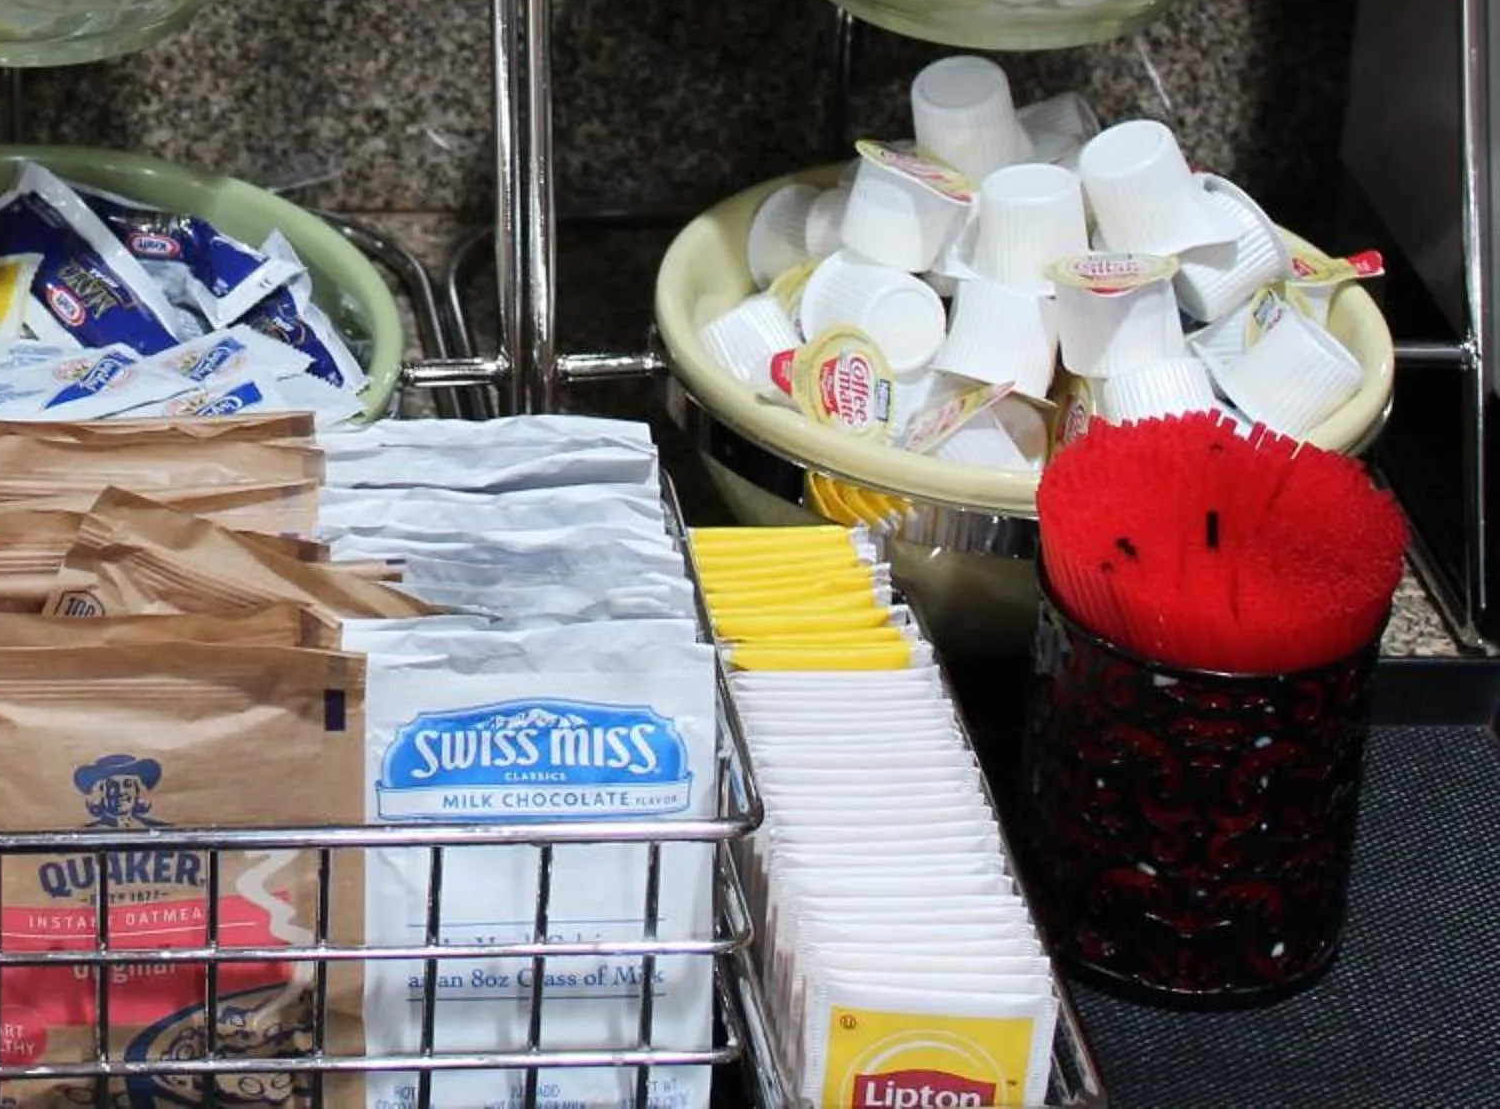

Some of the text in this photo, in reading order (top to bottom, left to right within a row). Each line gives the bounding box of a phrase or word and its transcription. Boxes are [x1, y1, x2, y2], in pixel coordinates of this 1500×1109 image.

[138, 237, 169, 252] Kraft
[849, 356, 869, 423] Coffee
[411, 724, 657, 779] SWISS MISS
[504, 771, 567, 782] CLASSICS
[442, 791, 678, 810] MILK CHOCOLATE FLAVOR
[37, 850, 201, 898] QUAKER
[125, 906, 203, 926] OATMEA
[471, 969, 509, 988] 8oz
[584, 965, 608, 986] of
[864, 1080, 981, 1108] Lipton
